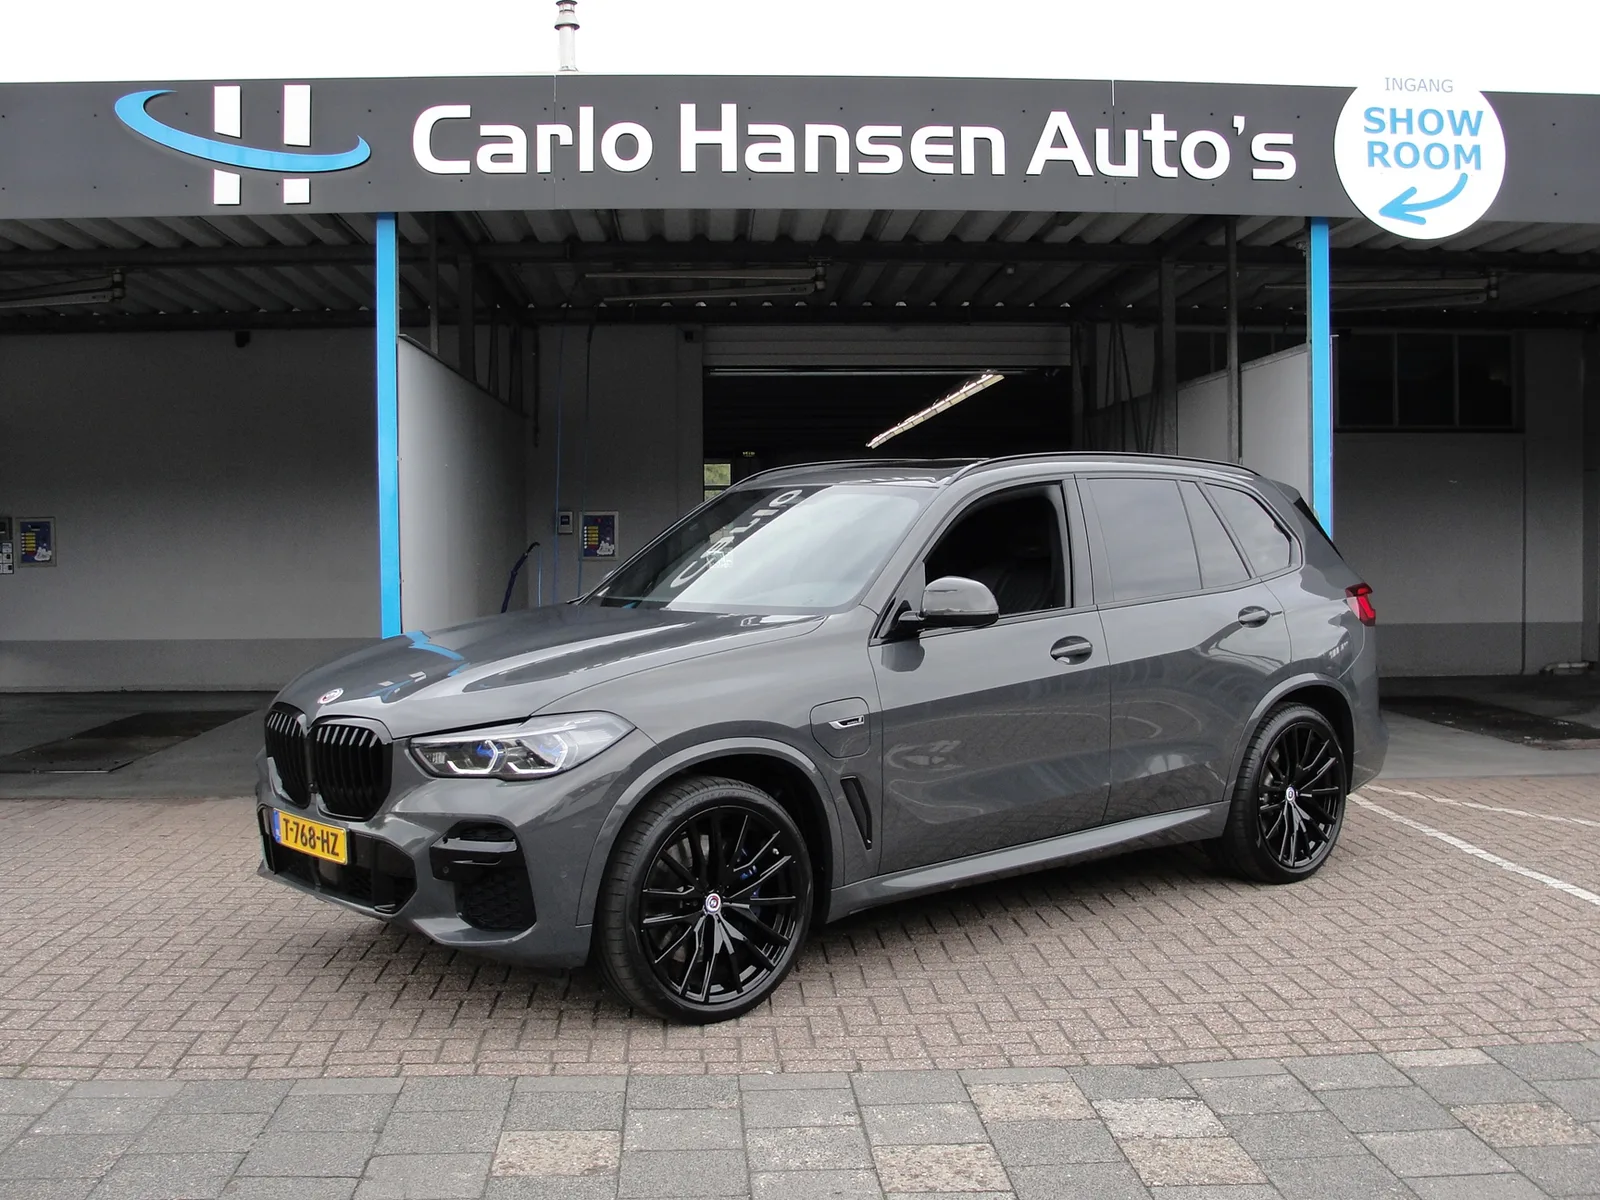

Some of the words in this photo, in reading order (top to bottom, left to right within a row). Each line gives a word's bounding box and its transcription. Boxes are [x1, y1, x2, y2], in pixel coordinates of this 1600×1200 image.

[1384, 76, 1454, 93] INGANG
[1363, 106, 1484, 137] SHOW
[412, 104, 653, 175] Carlo
[680, 103, 1006, 176] Hansen
[1025, 110, 1297, 181] Auto's
[1366, 140, 1482, 171] ROOM
[282, 817, 340, 857] T-768-HZ
